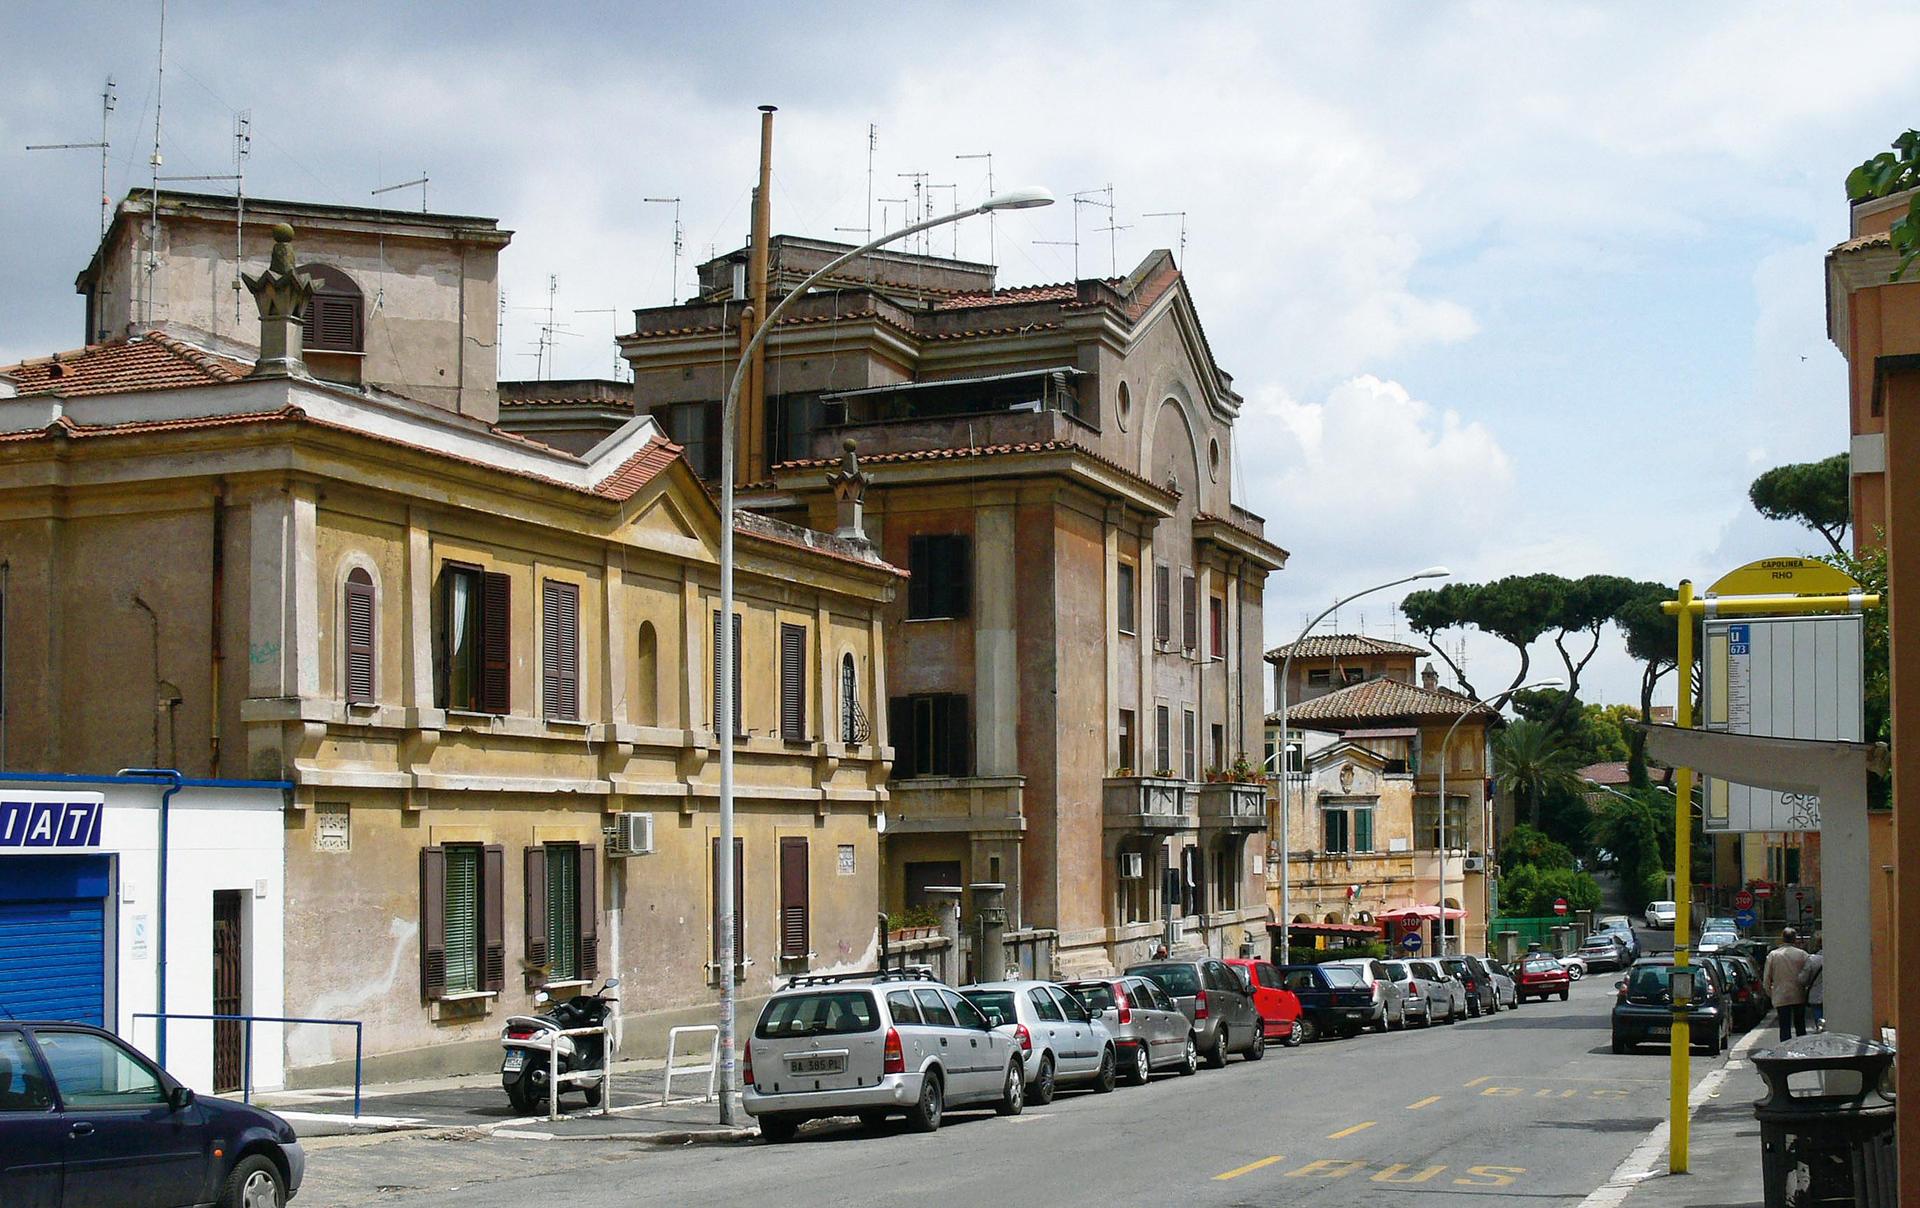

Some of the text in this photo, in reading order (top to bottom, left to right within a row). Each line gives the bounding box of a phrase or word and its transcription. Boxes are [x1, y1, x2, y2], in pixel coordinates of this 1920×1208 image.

[1761, 561, 1804, 569] CAPOLINEA
[1771, 571, 1793, 580] RHO
[1730, 645, 1746, 654] 673
[1735, 896, 1750, 905] STOP
[1402, 918, 1420, 927] STOP
[1284, 1158, 1527, 1187] BUS
